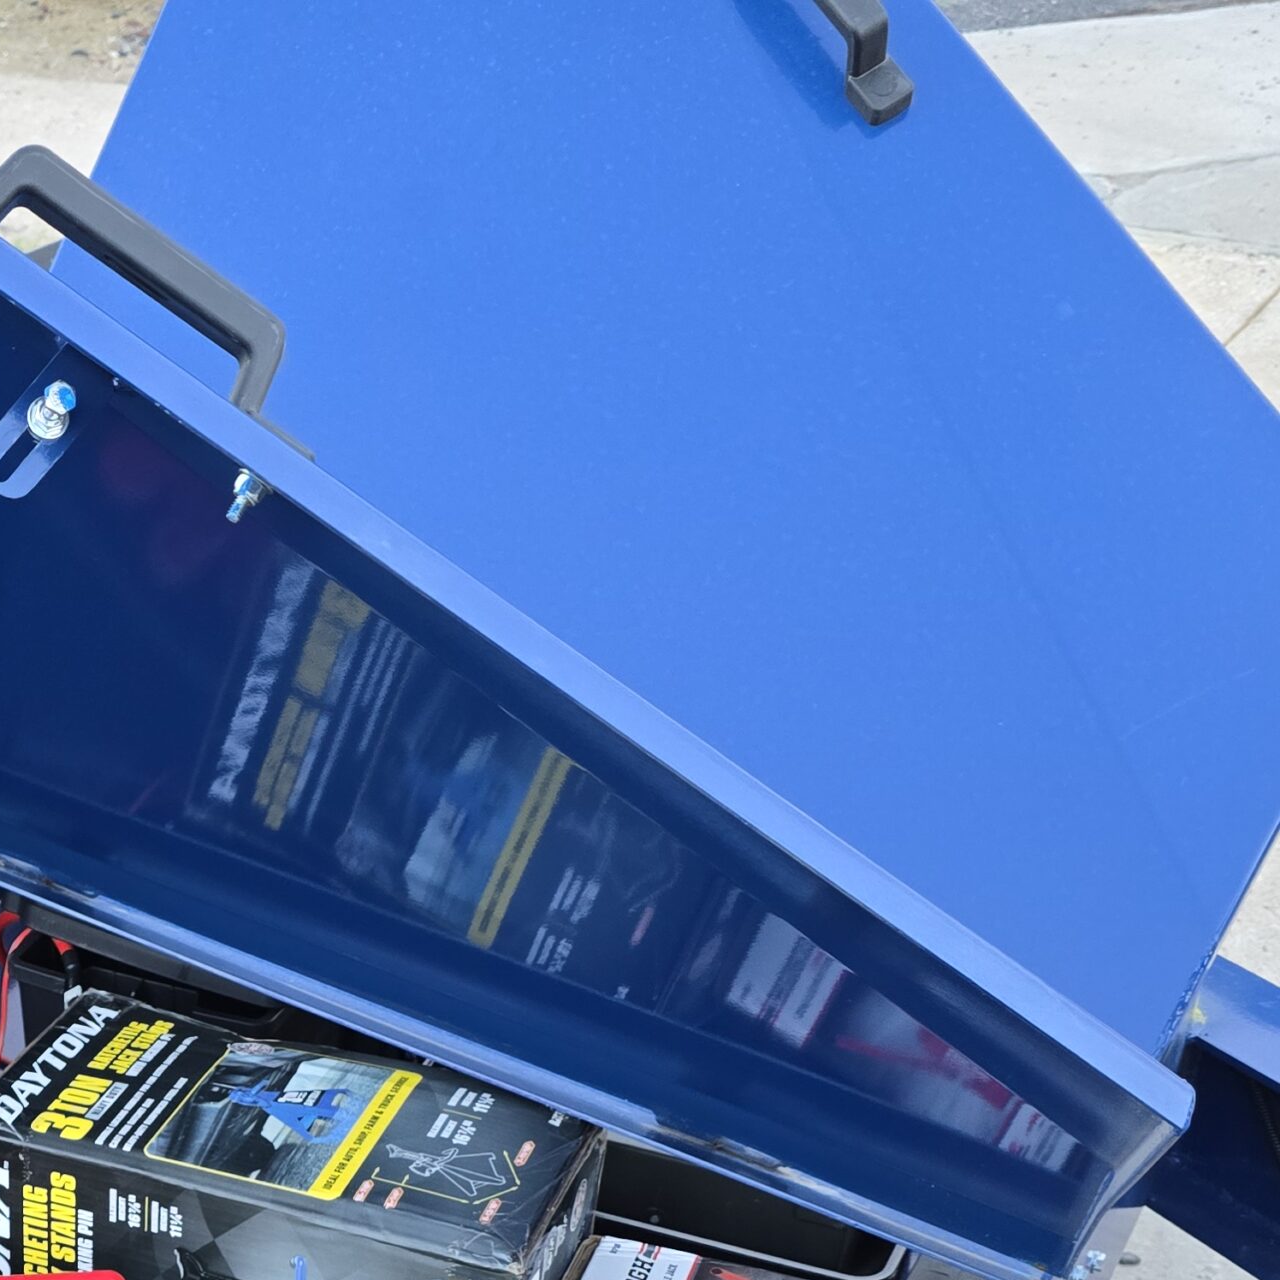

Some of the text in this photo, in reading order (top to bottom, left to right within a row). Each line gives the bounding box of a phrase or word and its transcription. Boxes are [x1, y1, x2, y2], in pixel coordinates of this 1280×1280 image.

[109, 1051, 143, 1074] JACK
[31, 1074, 113, 1140] 3 TON
[323, 1172, 339, 1190] IDEAL
[335, 1156, 347, 1173] FOR
[363, 1112, 378, 1131] FARM
[381, 1092, 396, 1110] TRUCK
[23, 1184, 48, 1275] CHETING
[50, 1171, 77, 1263] STANDS
[77, 1209, 94, 1272] KING PIN
[667, 1263, 678, 1278] JACK
